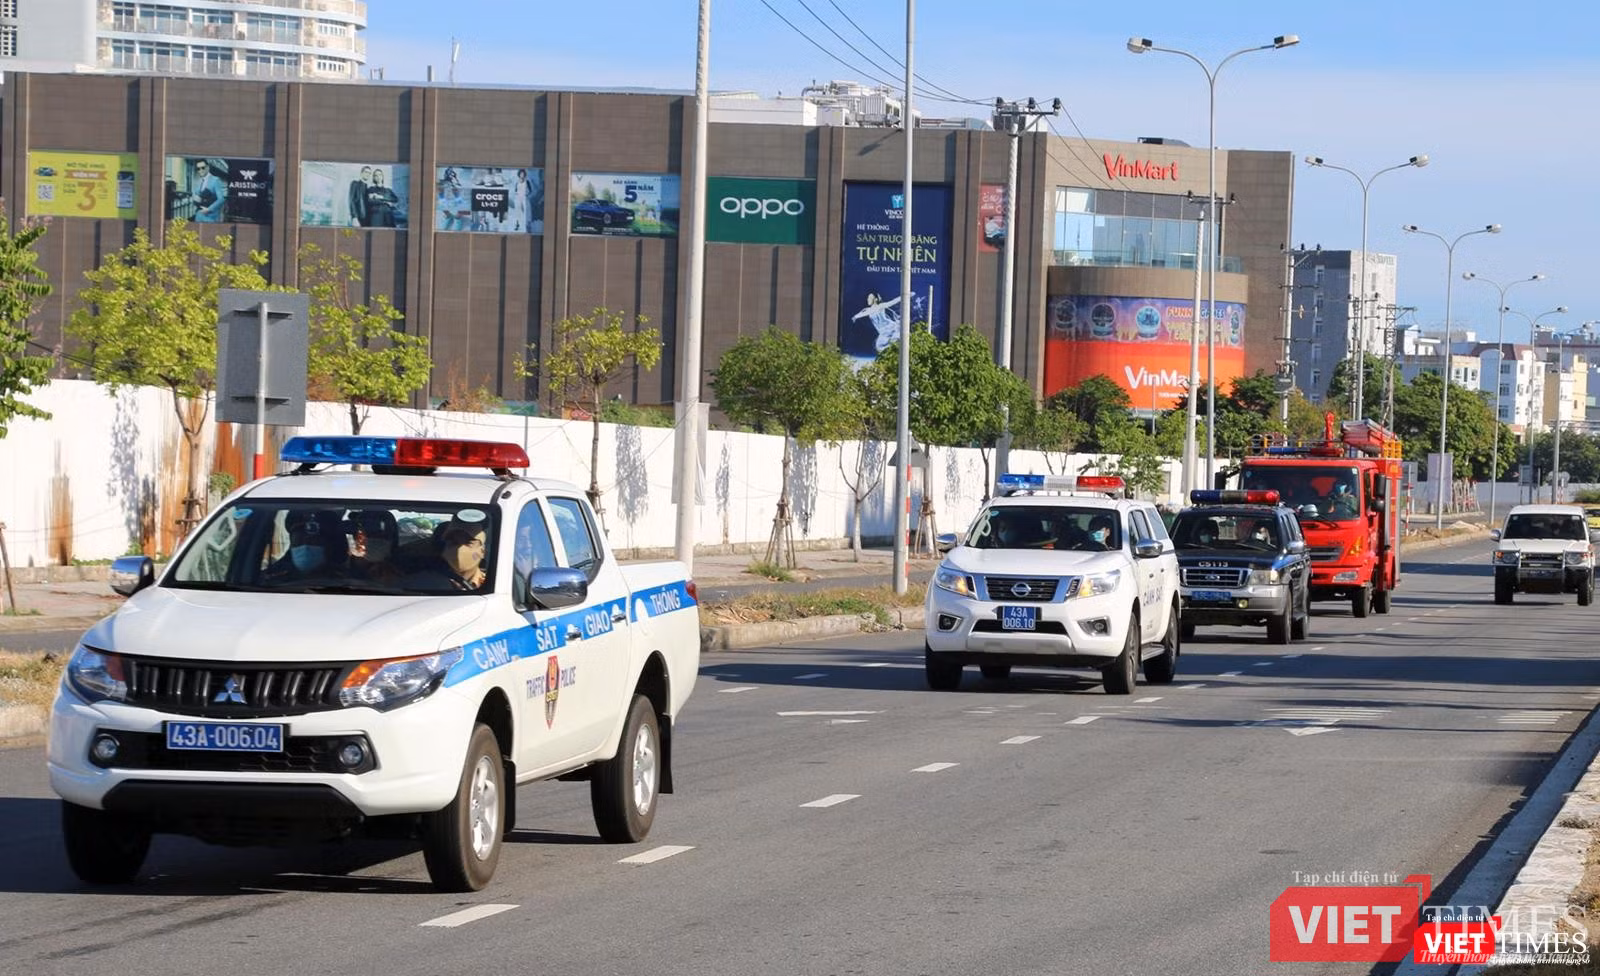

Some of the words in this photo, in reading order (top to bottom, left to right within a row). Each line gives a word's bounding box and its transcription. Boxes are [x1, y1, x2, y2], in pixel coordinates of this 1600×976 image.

[1103, 152, 1179, 181] VinMart
[229, 181, 266, 190] ARISTINO
[624, 185, 638, 203] 5
[77, 181, 97, 211] 3
[475, 193, 504, 201] crocs
[720, 197, 804, 219] oppo
[877, 234, 903, 245] TRƯỢ
[856, 245, 880, 264] TỰ
[1167, 306, 1194, 317] FUNN
[1200, 308, 1225, 319] GAES
[1124, 365, 1201, 390] VinMat
[1010, 606, 1028, 618] 43A
[472, 638, 512, 670] CẢNH
[536, 621, 559, 652] SÁT
[585, 610, 611, 637] GIAO
[649, 586, 681, 616] THÔNG
[1004, 617, 1034, 629] 006.10
[526, 675, 545, 700] TRAFFIC
[561, 665, 577, 689] POLICE
[171, 724, 279, 749] 43A-006.04
